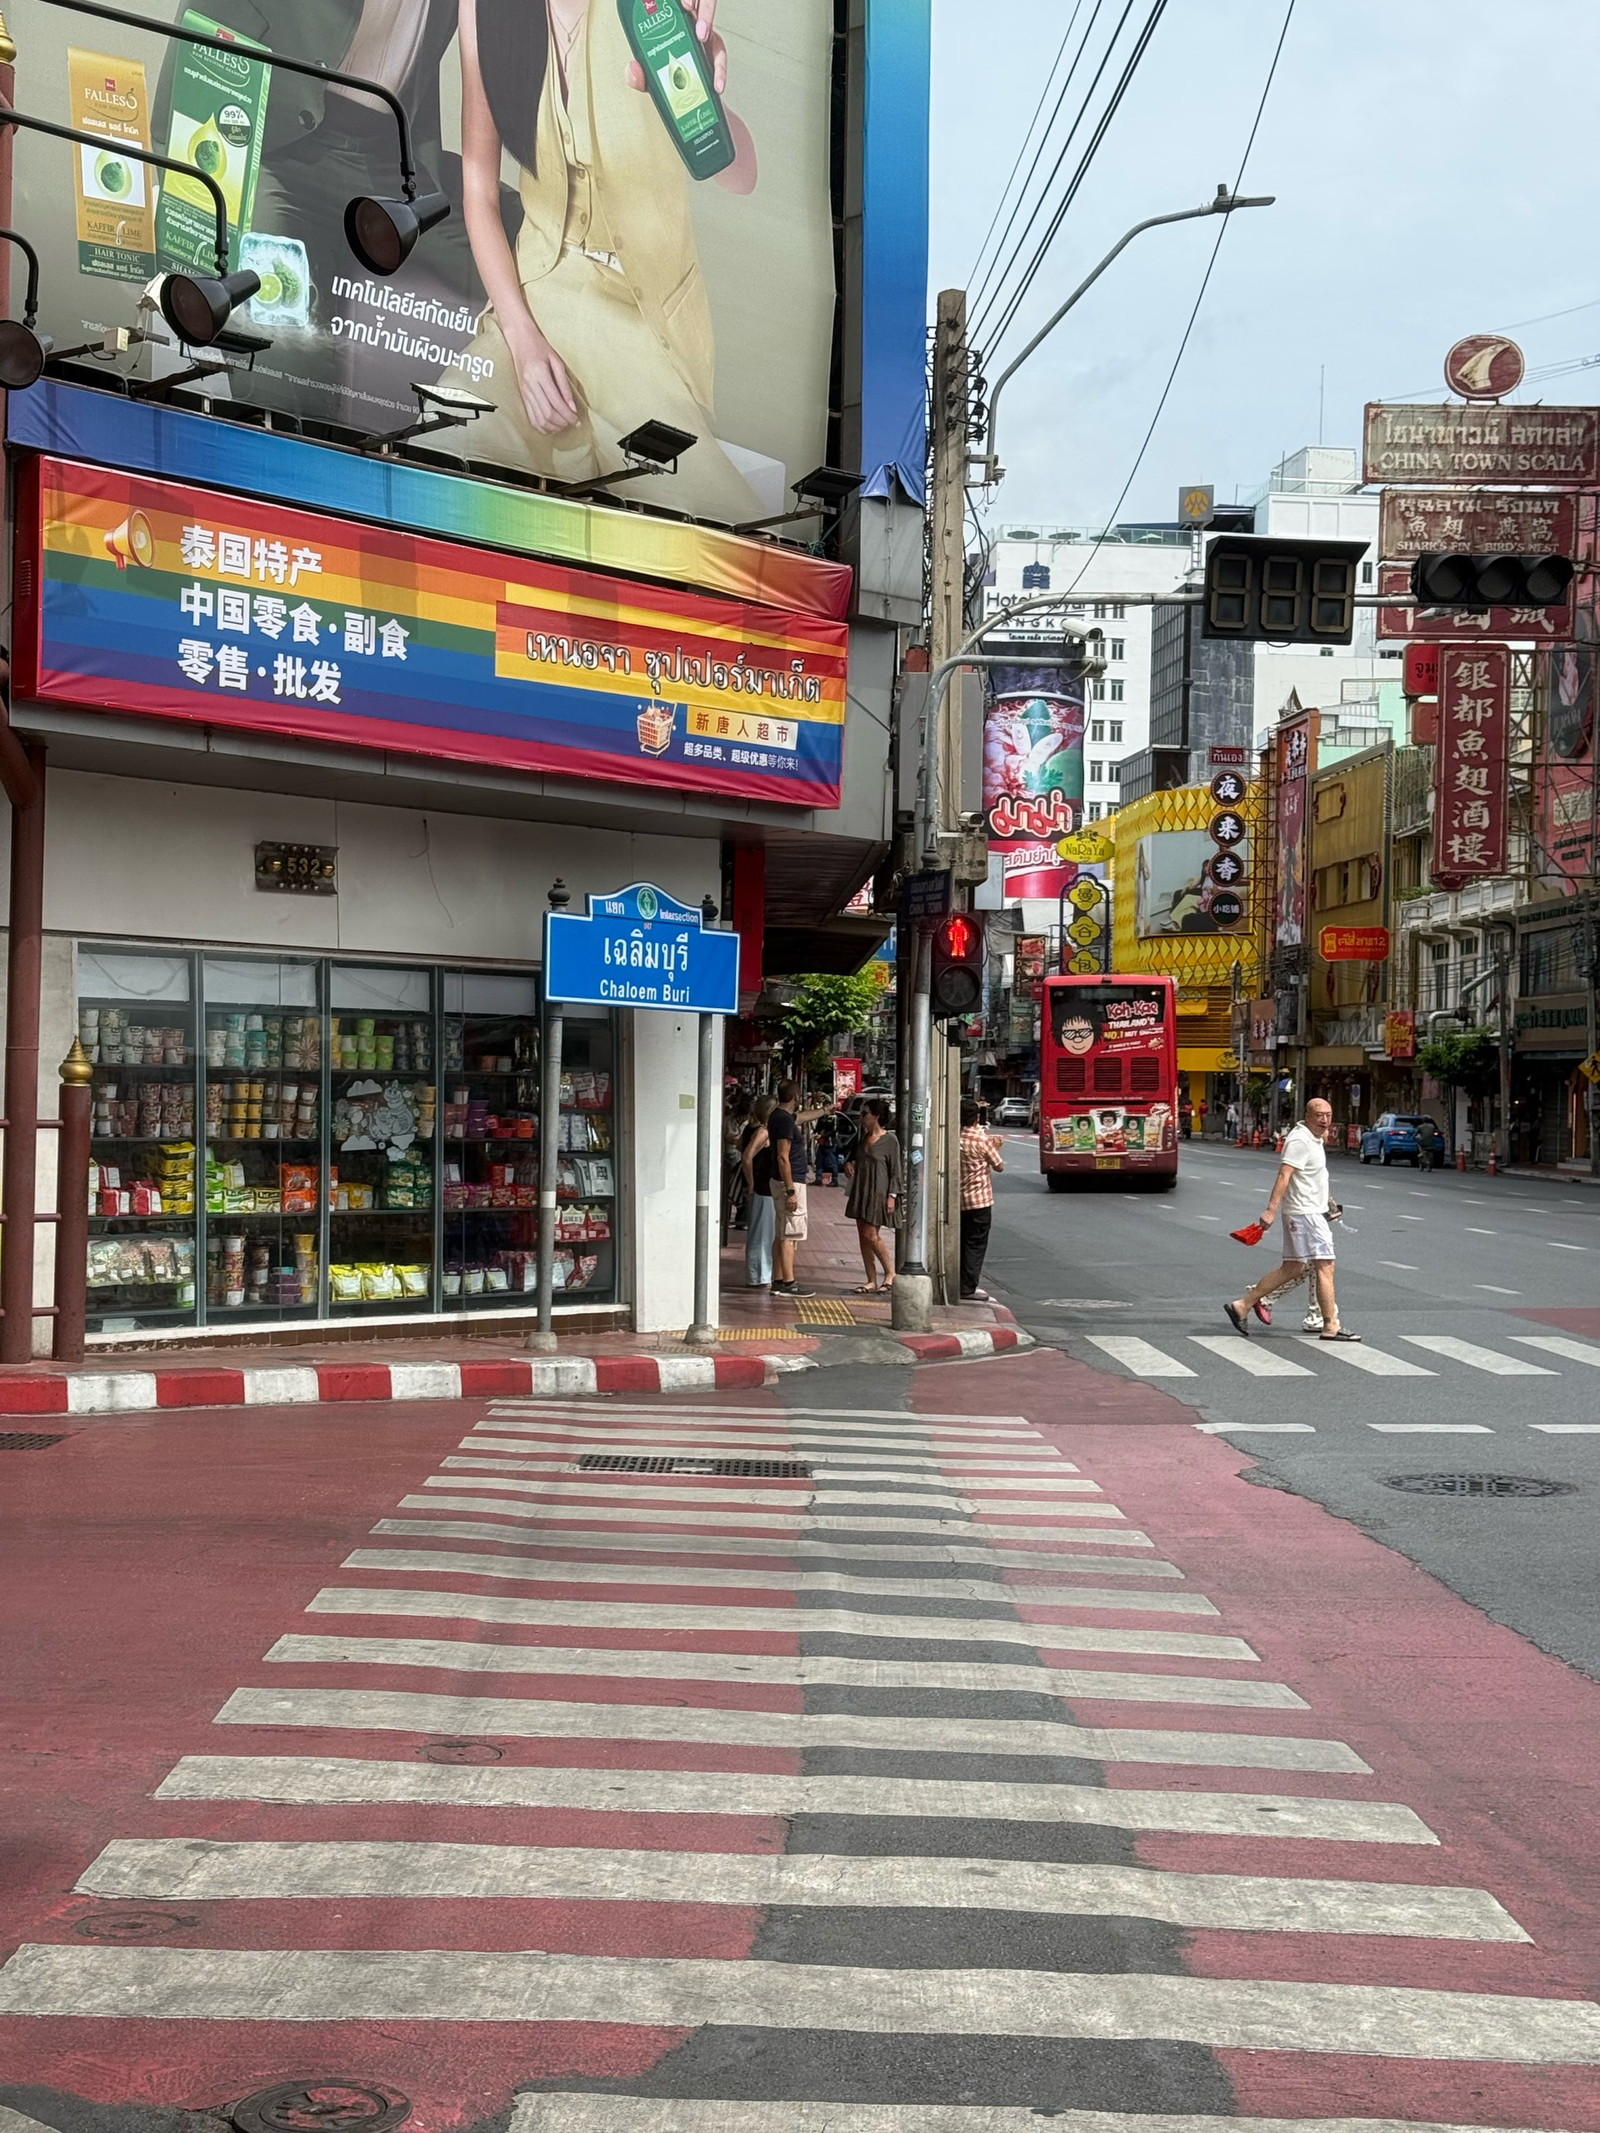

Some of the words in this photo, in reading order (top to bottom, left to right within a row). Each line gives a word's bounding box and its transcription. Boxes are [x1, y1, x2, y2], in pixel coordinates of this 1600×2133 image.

[87, 220, 115, 233] KAFFIR
[165, 230, 195, 251] KAFFIR
[94, 247, 115, 258] HAIR
[116, 251, 140, 262] TONIC
[331, 275, 479, 336] เทคโนโลยีสกัดเย็น
[330, 314, 495, 383] จากน้ำมันผิวมะกรูด
[1383, 414, 1500, 446] ไชน่าทาวน์
[1510, 418, 1585, 446] สกาล่า
[1381, 451, 1442, 471] CHINA
[1452, 452, 1512, 471] TOWN
[1517, 453, 1586, 472] SCALA
[179, 524, 323, 587] 泰国特产
[1396, 540, 1447, 551] SHARK'S
[1450, 541, 1471, 551] FIN
[1485, 542, 1525, 552] BIRD'S
[1528, 543, 1560, 553] NEST
[644, 645, 822, 704] ซุปเปอร์มาเก็ต
[694, 711, 790, 744] 新唐人超市
[1213, 749, 1243, 763] กันเอง
[1446, 660, 1498, 867] 銀都魚翅酒樓
[1065, 843, 1105, 856] NaRaYa
[287, 856, 320, 876] 532
[605, 900, 625, 915] แยก
[659, 908, 699, 923] Intersection
[603, 928, 689, 982] เฉลิมบุรี
[600, 978, 657, 1001] Chaloem
[663, 984, 690, 1003] Buri
[1106, 1000, 1159, 1020] Koh-Kae
[1108, 1017, 1156, 1030] THAILAND'S
